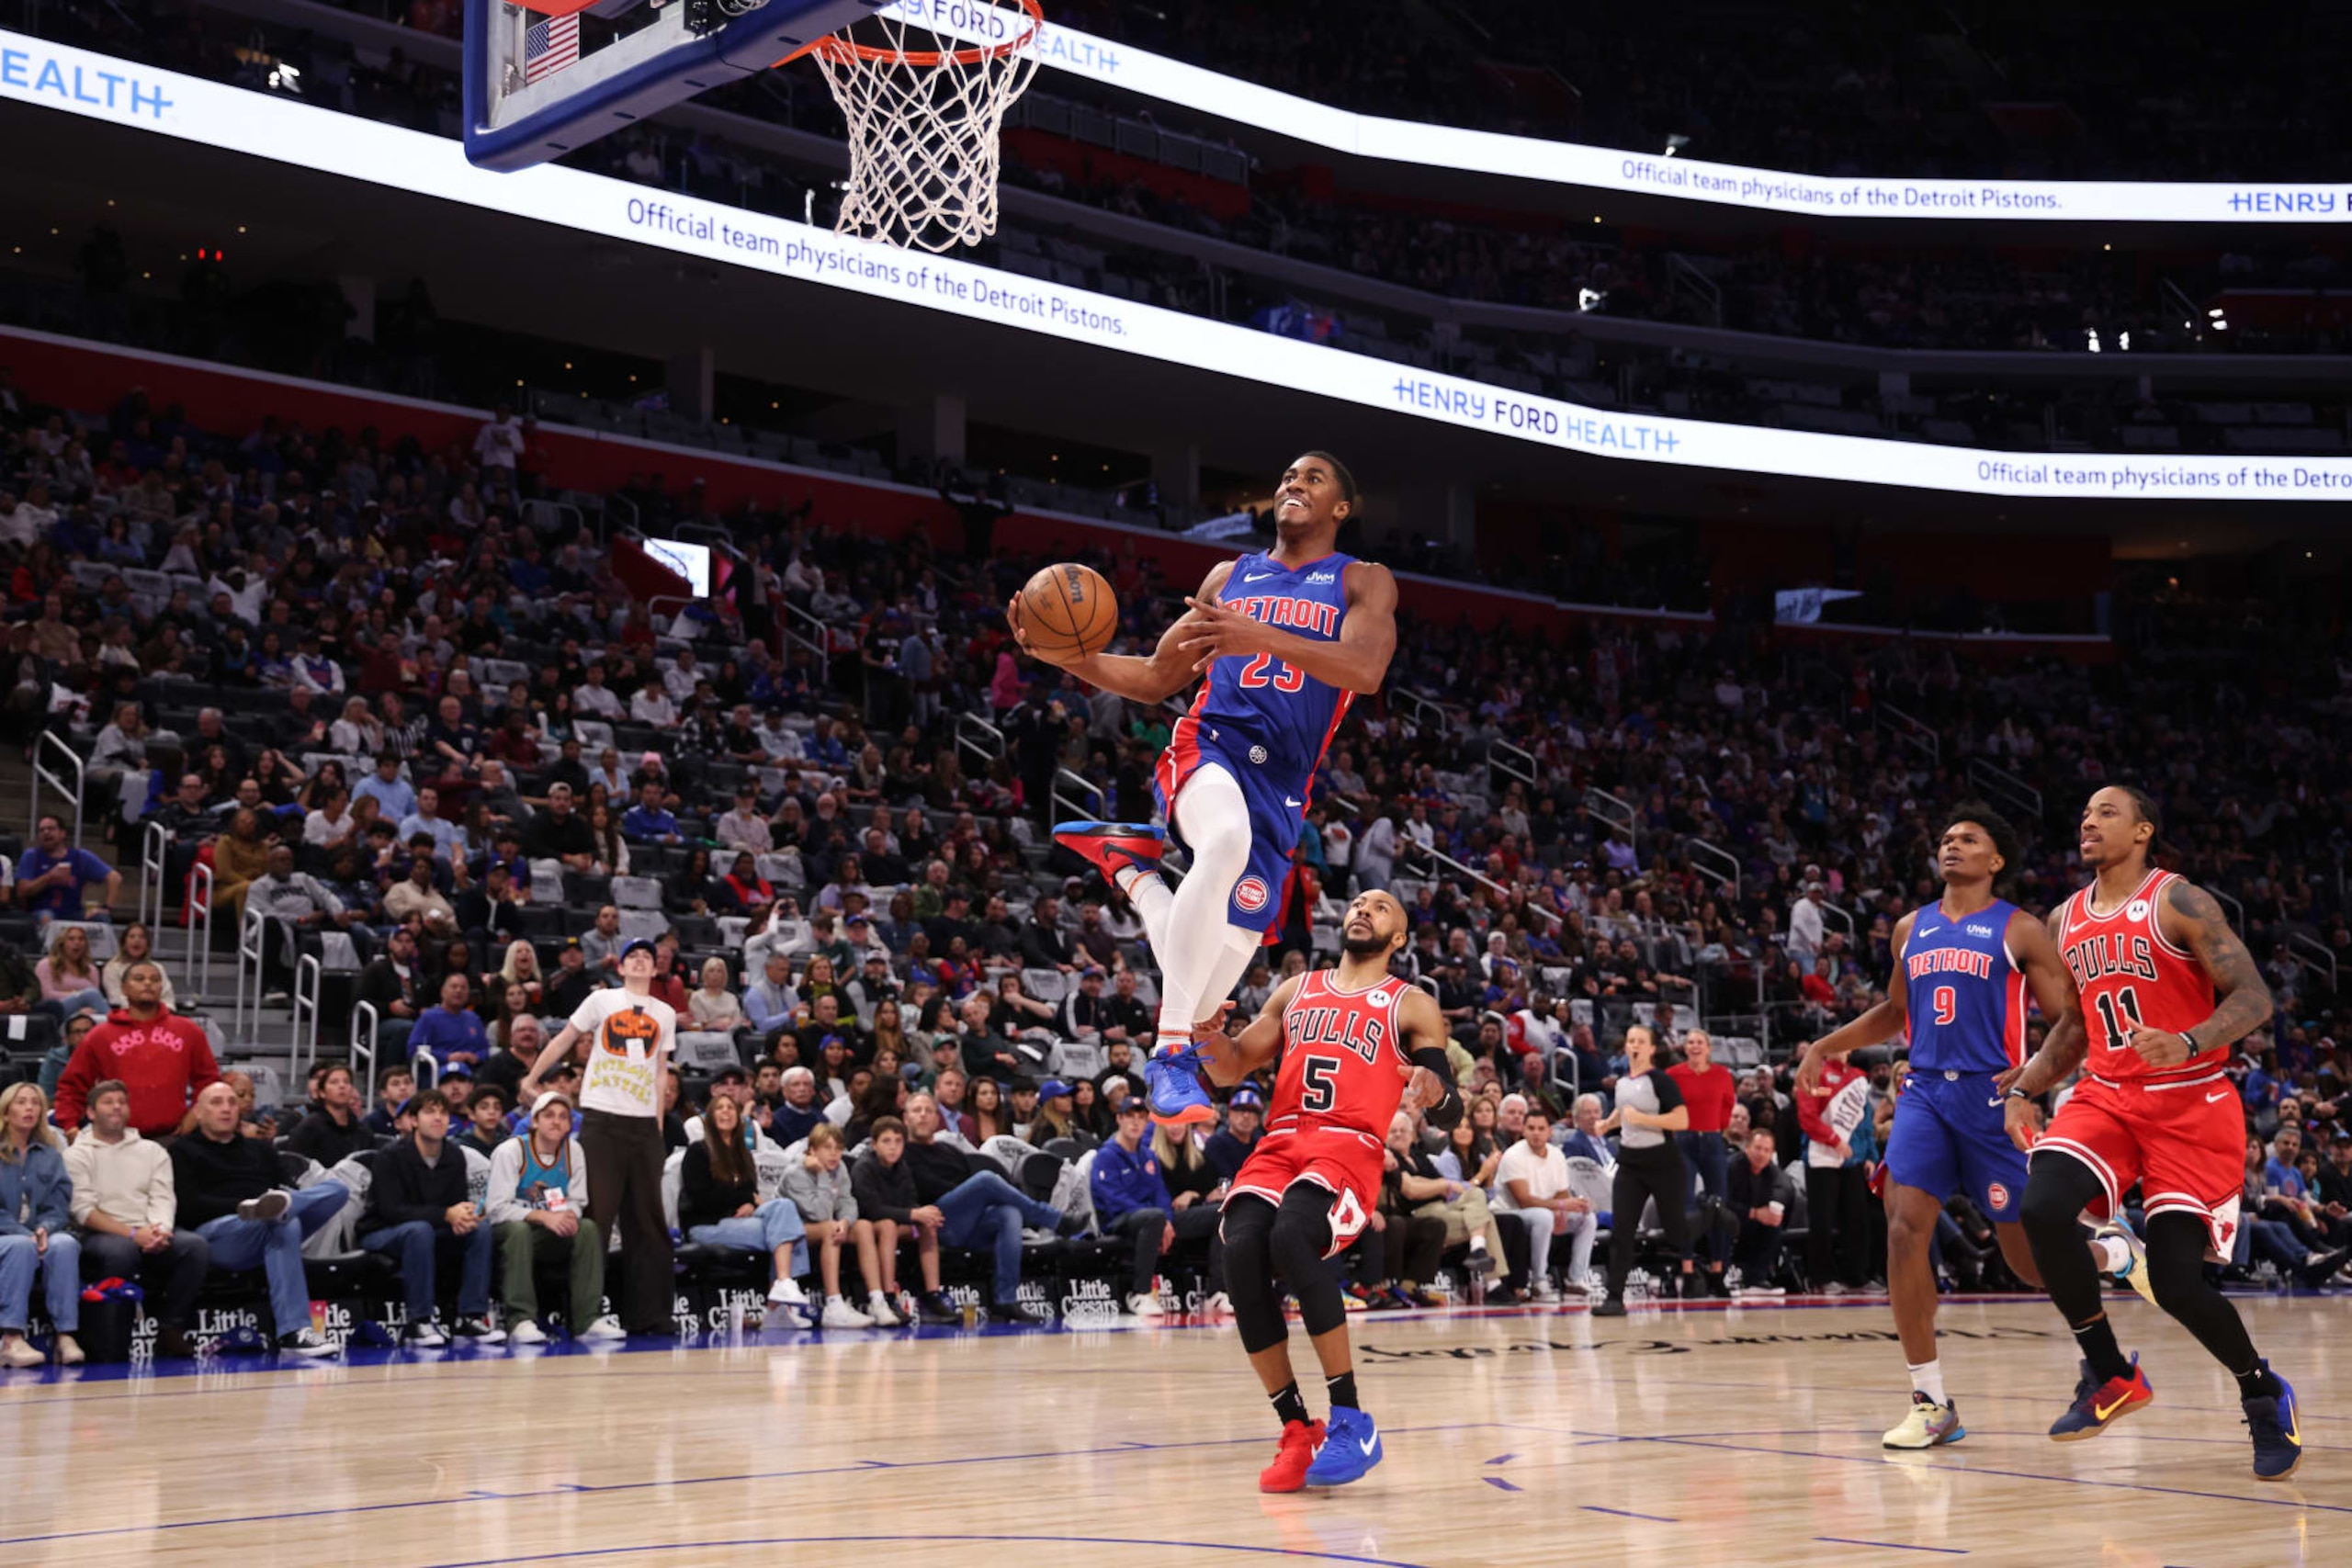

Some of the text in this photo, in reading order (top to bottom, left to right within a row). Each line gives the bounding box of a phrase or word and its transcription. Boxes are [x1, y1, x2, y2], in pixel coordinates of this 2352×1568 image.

[933, 0, 1005, 39] FORD
[1622, 159, 2064, 209] Official team physicians of the Detroit Pistons.
[2227, 192, 2335, 213] HENRY
[628, 197, 1128, 336] Official team physicians of the Detroit Pistons.
[1393, 377, 1680, 454] HENRY FORD HEALTH
[1977, 459, 2049, 485] Official
[2053, 468, 2107, 485] team
[2111, 466, 2222, 491] physicians
[2226, 466, 2249, 486] of
[2254, 468, 2289, 488] the
[1966, 924, 1993, 936] UWM
[1907, 947, 1994, 981] DETROIT
[2065, 932, 2159, 995] BULLS
[1933, 986, 1956, 1026] 9
[2096, 986, 2143, 1052] 11
[1286, 1007, 1385, 1066] BULLS
[1302, 1054, 1341, 1113] 5
[1061, 1295, 1119, 1317] Caesars
[1069, 1278, 1111, 1300] Little
[198, 1307, 258, 1335] Little
